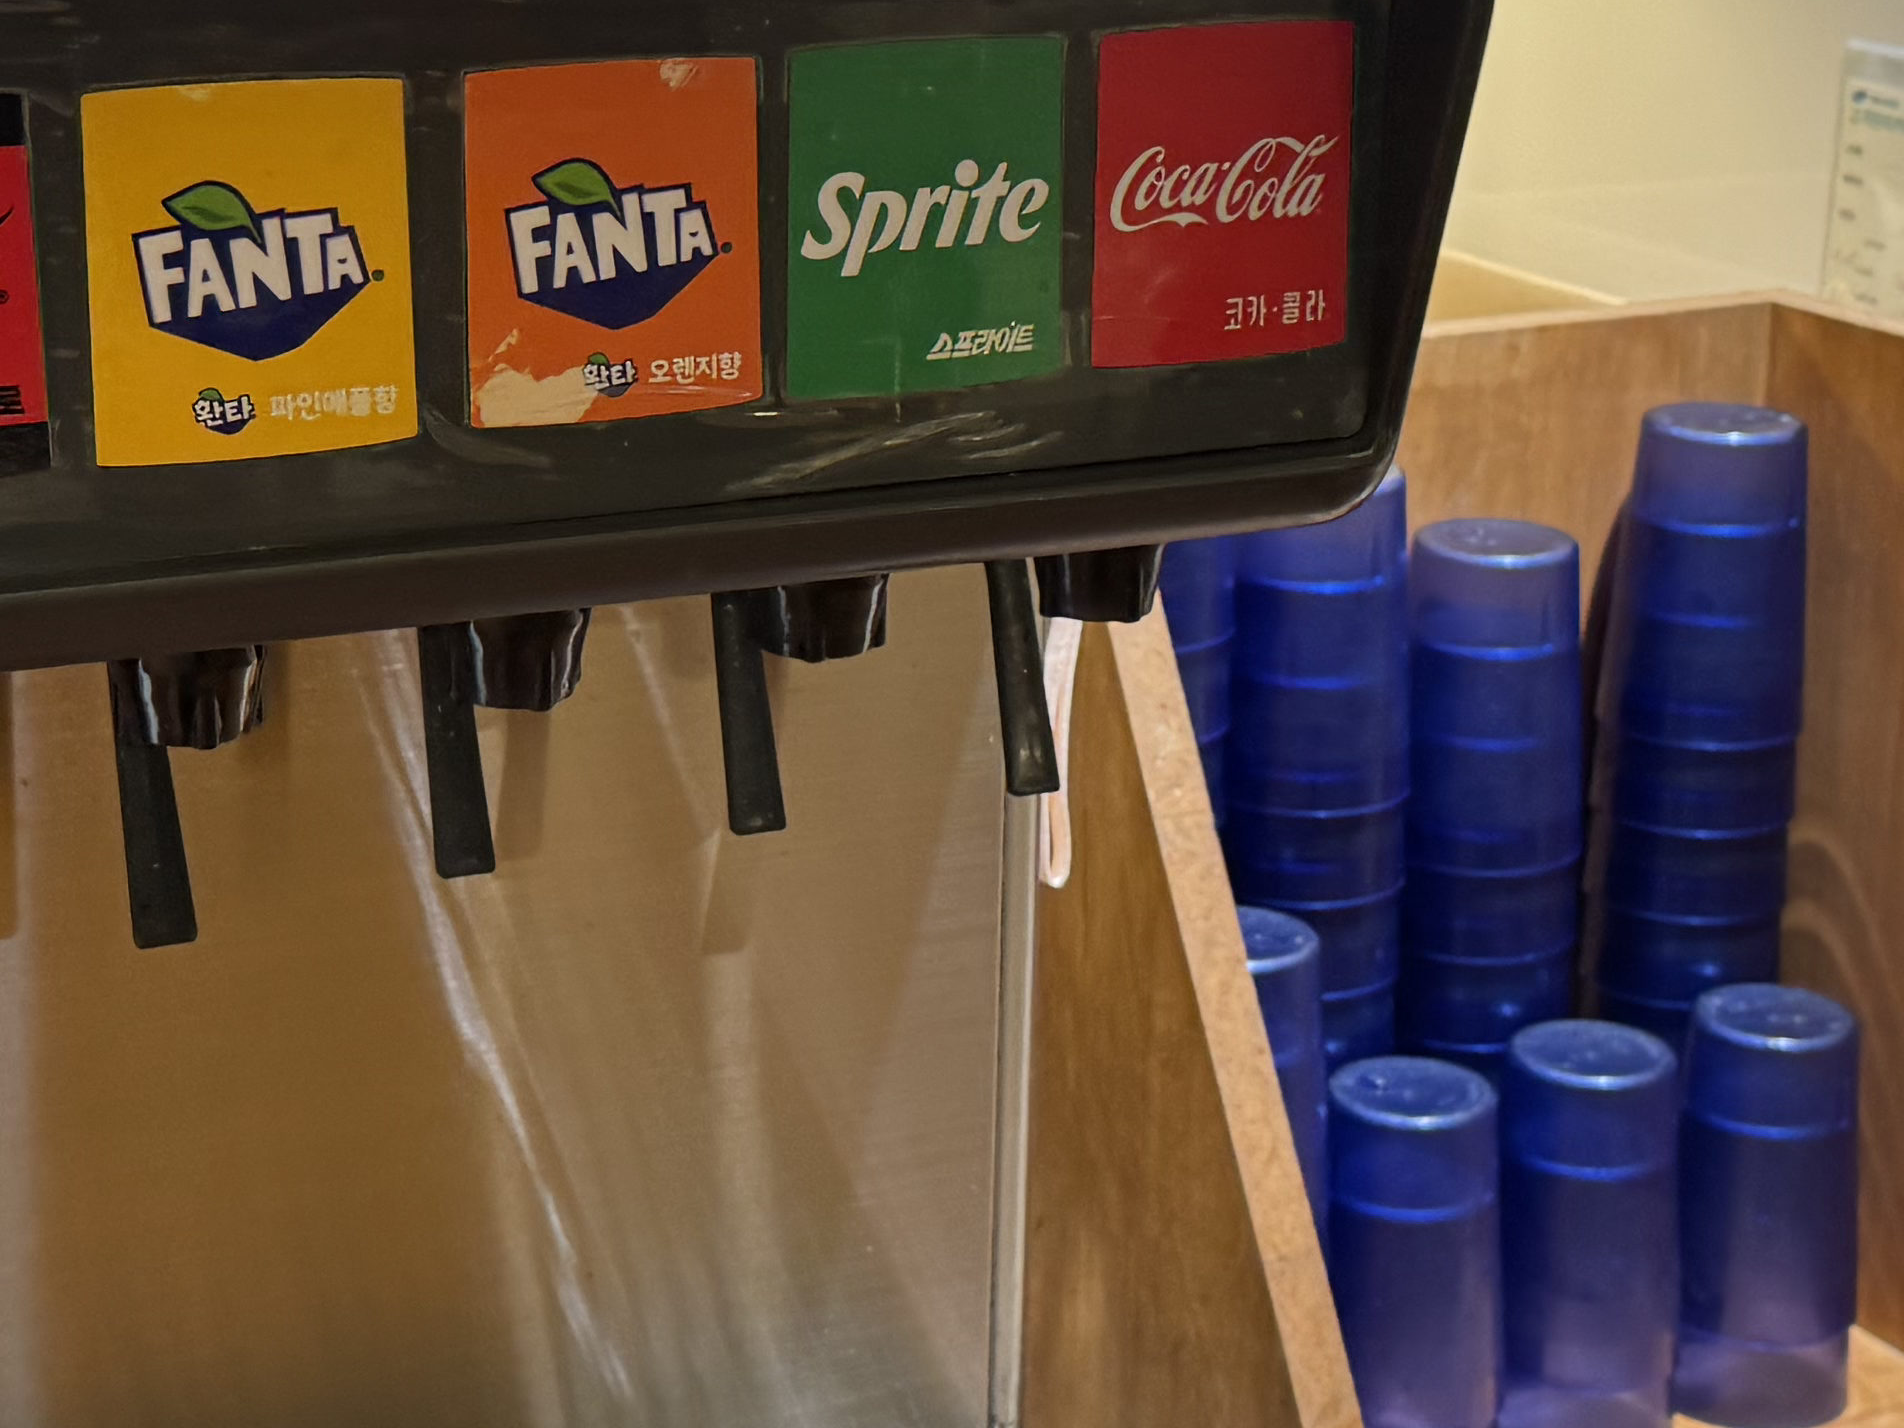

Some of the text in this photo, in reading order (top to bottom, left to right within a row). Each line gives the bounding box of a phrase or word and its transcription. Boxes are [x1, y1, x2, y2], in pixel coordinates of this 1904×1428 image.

[800, 159, 1049, 277] Sprite
[1109, 134, 1340, 232] Coca-Cola
[137, 212, 365, 325] FANTA
[508, 186, 715, 295] FANTA
[583, 350, 743, 390] 환타 오렌지향
[926, 321, 1034, 361] 스프라이트
[194, 384, 399, 428] 환타 파인애플향
